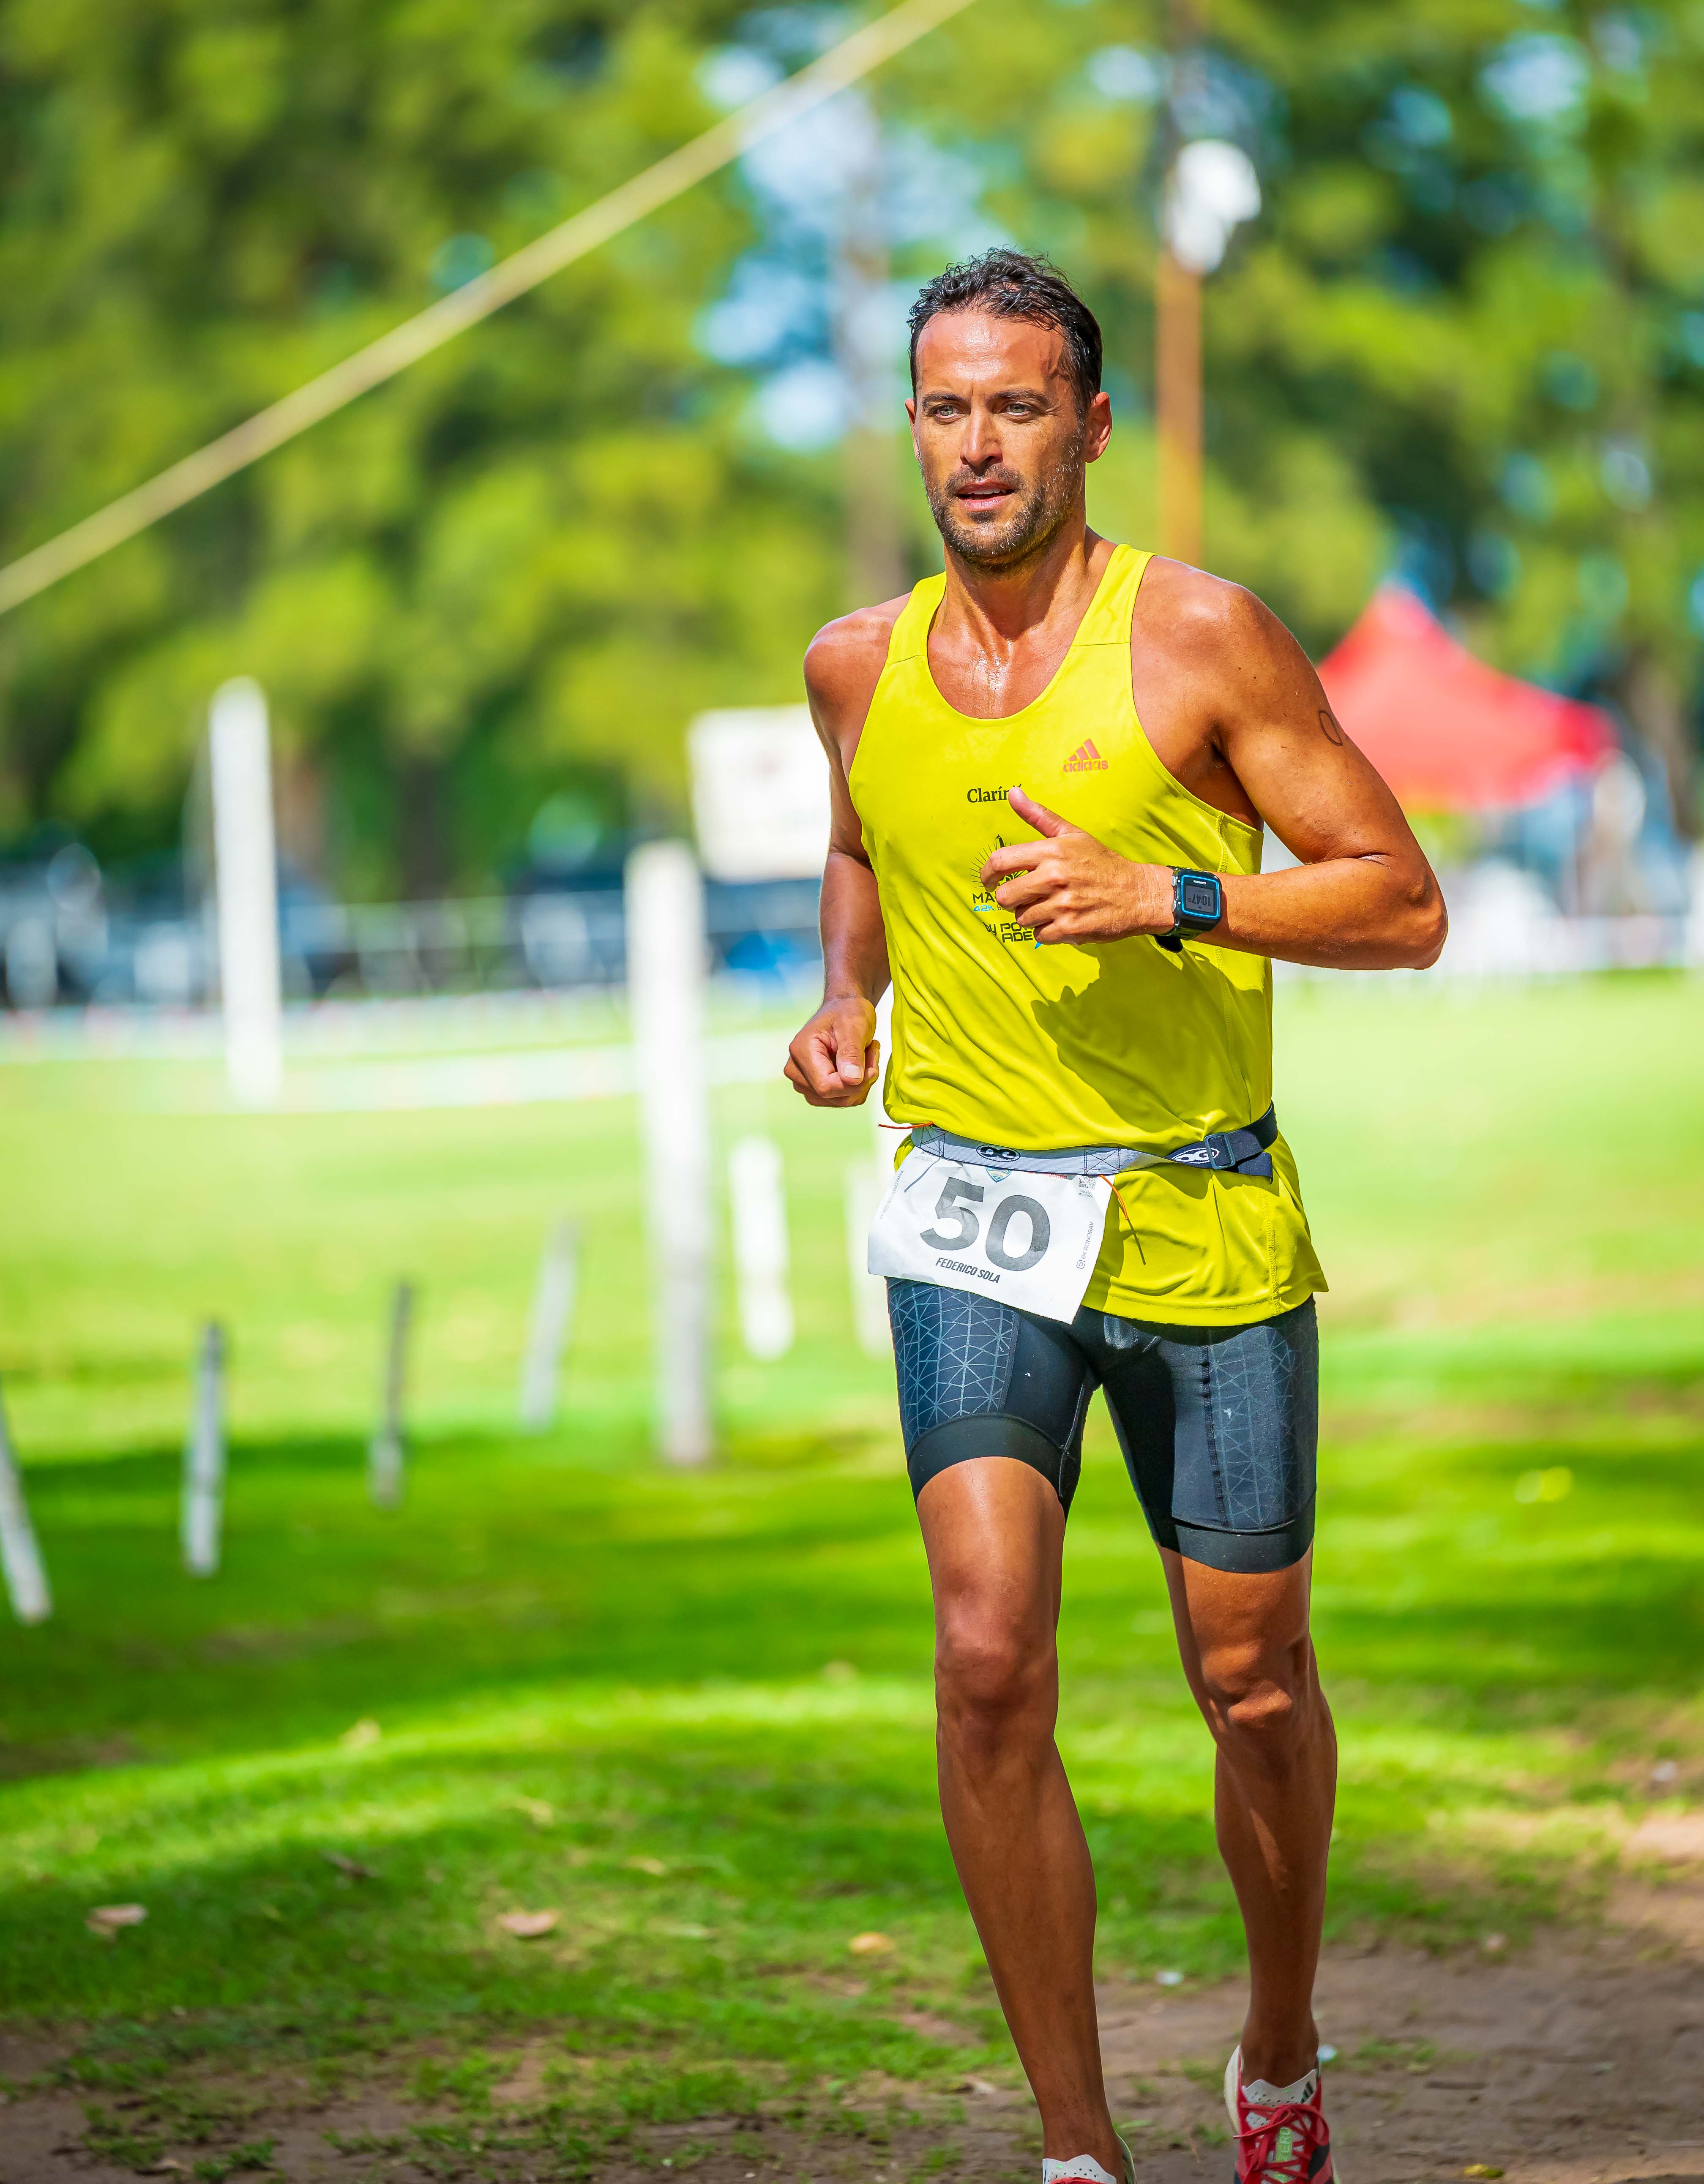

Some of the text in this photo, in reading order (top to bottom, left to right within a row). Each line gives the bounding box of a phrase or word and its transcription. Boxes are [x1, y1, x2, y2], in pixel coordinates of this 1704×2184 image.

[1063, 760, 1108, 773] adidas
[1000, 922, 1033, 932] PO
[1002, 931, 1033, 943] ADE
[920, 1176, 1050, 1271] 50
[935, 1257, 1000, 1283] FEDERICO SOLA
